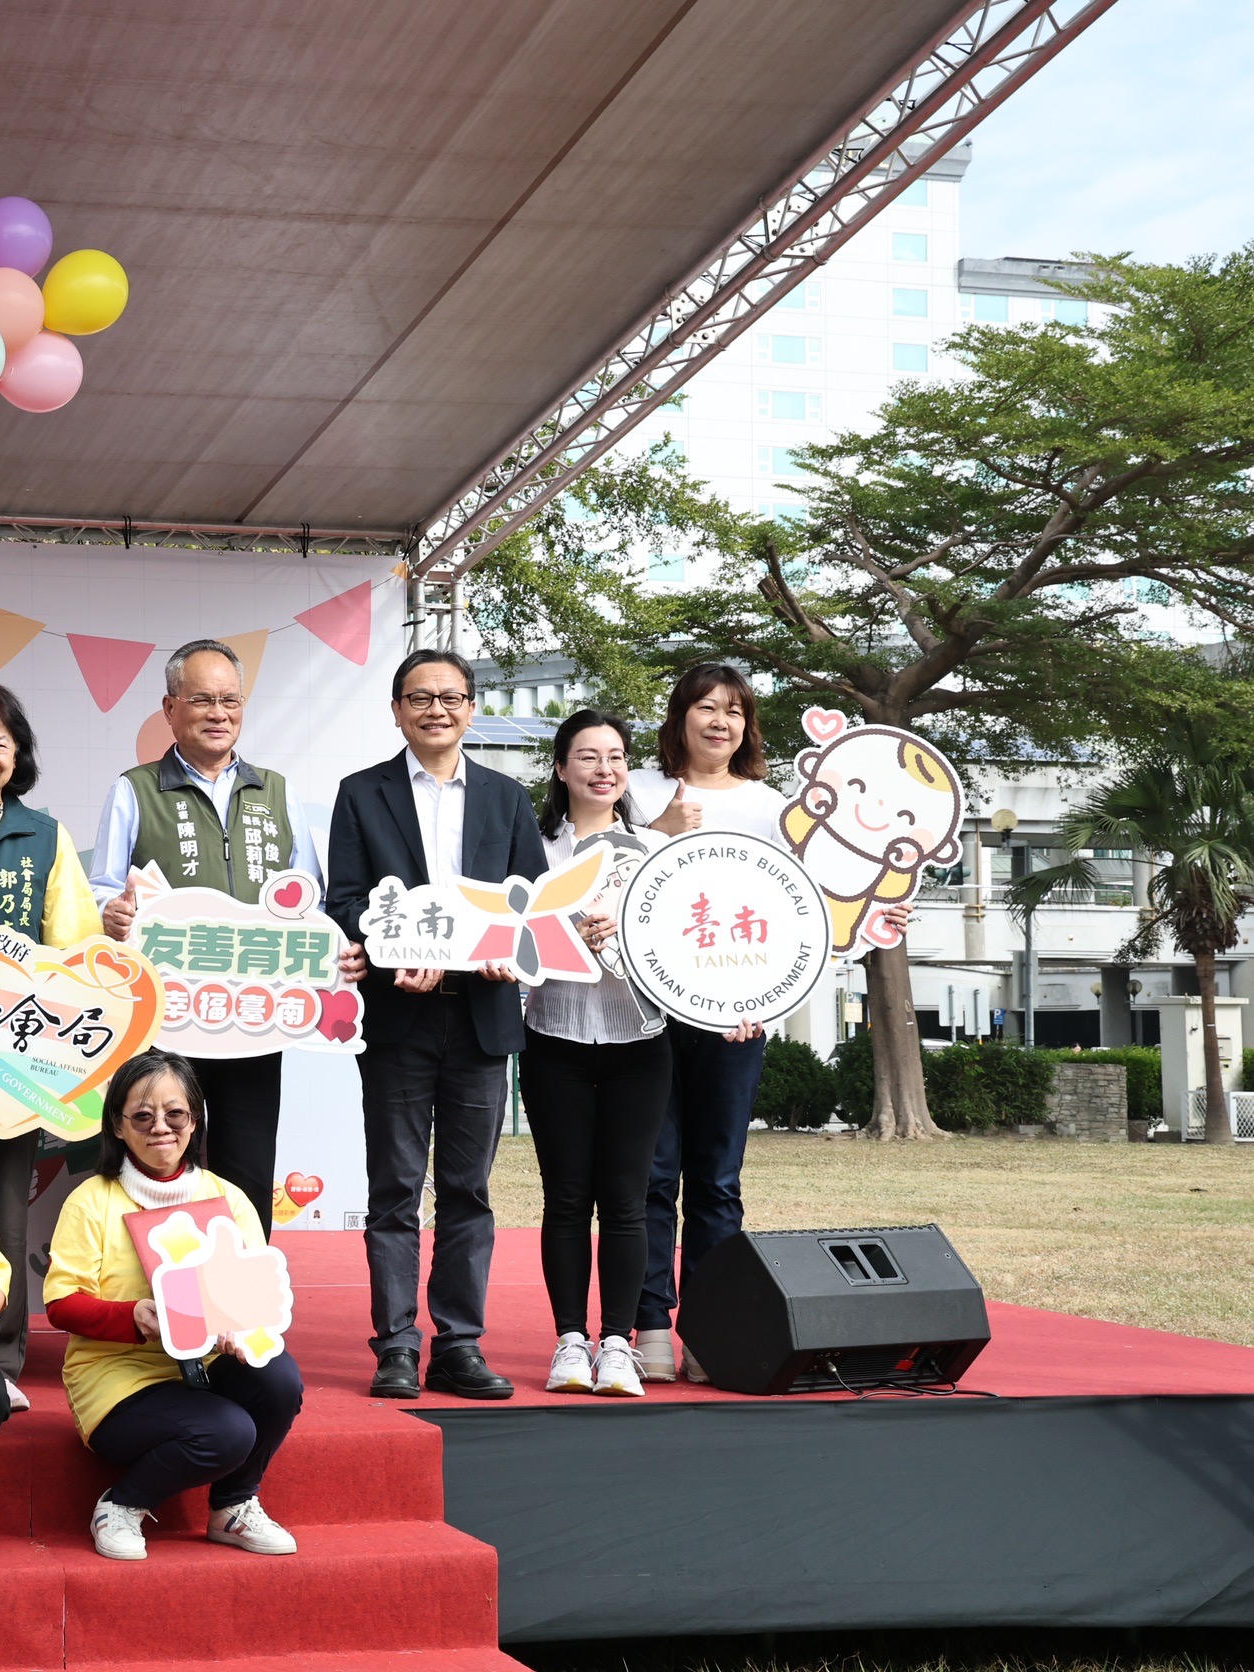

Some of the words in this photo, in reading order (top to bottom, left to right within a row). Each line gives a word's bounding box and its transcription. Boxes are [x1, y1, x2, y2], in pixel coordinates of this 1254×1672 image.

[176, 821, 200, 877] 陳明才
[262, 818, 280, 877] 林俊
[19, 856, 35, 926] 社會局局長
[368, 885, 455, 940] 臺南
[638, 870, 673, 924] SOCIAL
[677, 847, 749, 869] AFFAIRS
[756, 857, 809, 916] BUREAU
[682, 892, 768, 949] 臺南
[141, 922, 331, 979] 友善育兒
[375, 945, 451, 961] TAINAN
[644, 949, 685, 998] TAINAN
[690, 994, 726, 1012] CITY
[734, 941, 812, 1013] GOVERNMENT
[693, 952, 768, 969] TAINAN
[165, 989, 306, 1026] 幸福臺南
[30, 1065, 59, 1077] BUREAU
[31, 1056, 58, 1068] SOCIAL
[58, 1063, 87, 1075] AFFAIRS
[2, 1072, 76, 1127] GOVERNMENT
